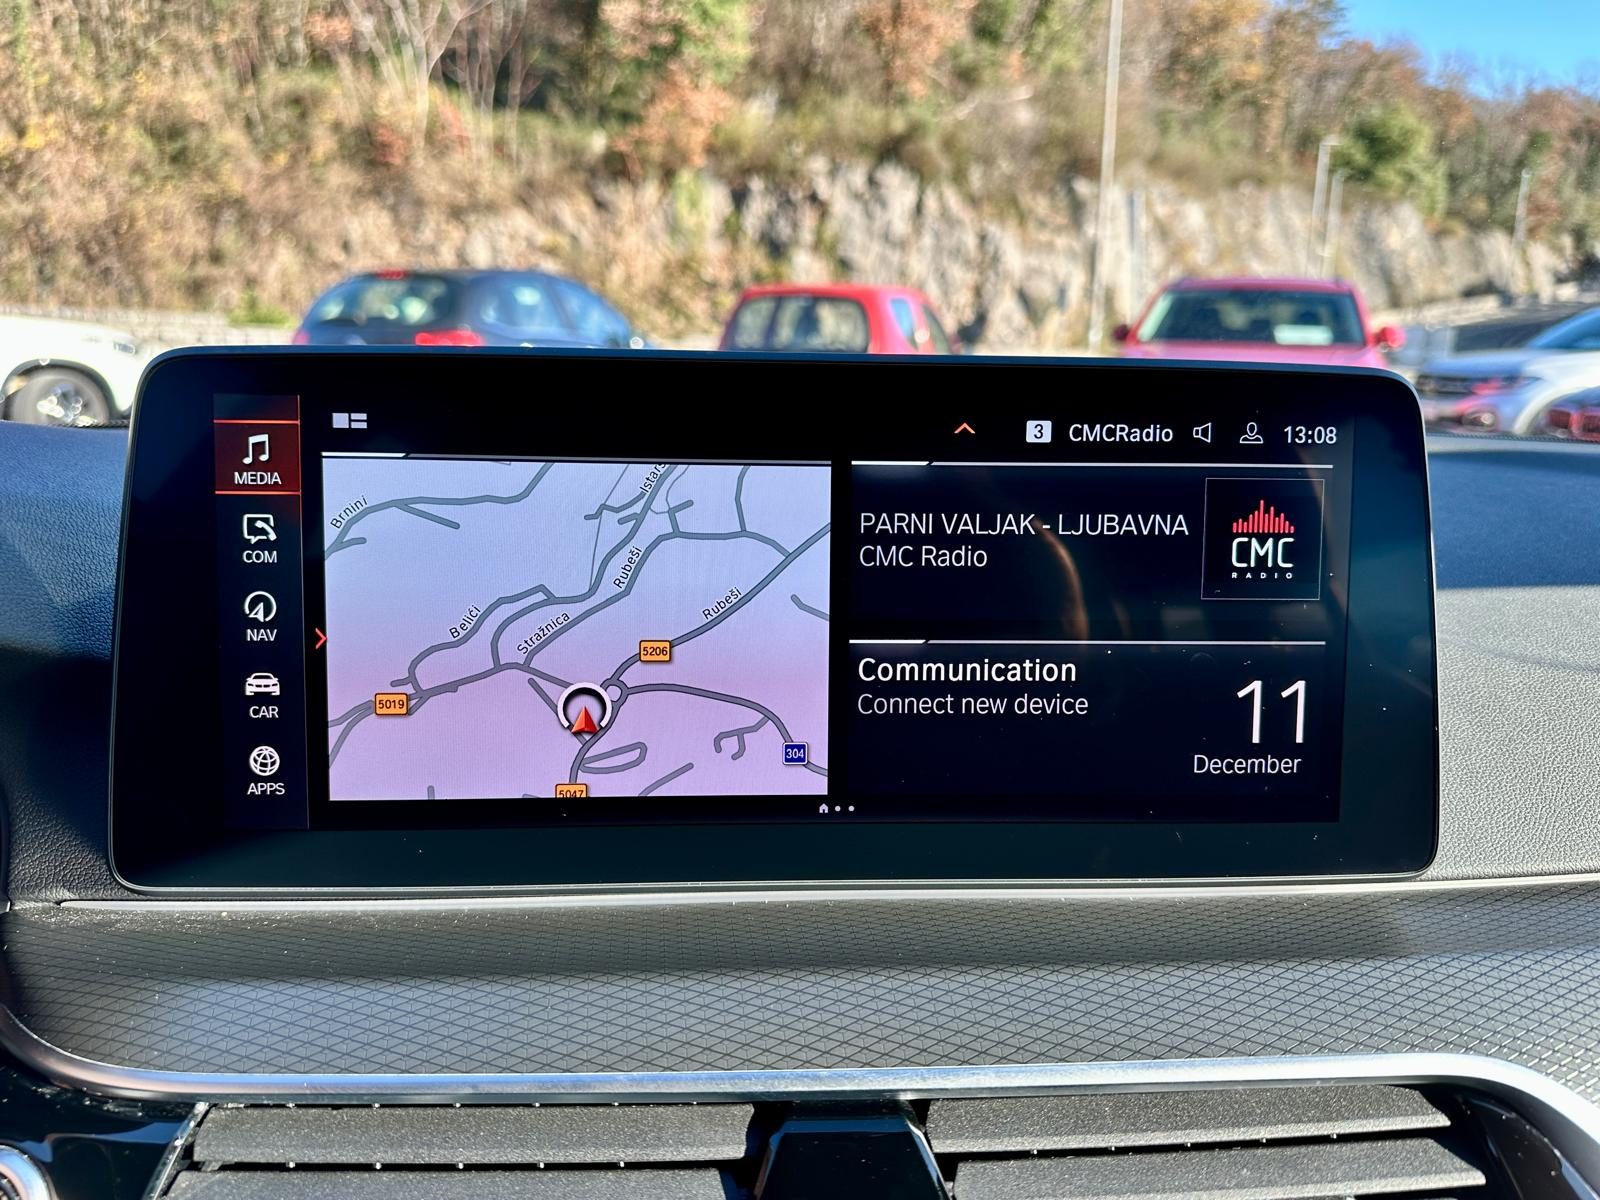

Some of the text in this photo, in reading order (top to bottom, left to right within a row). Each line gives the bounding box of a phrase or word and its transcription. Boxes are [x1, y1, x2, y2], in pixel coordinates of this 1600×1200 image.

[1033, 423, 1044, 440] 3
[1068, 424, 1174, 443] CMCRadio
[1283, 426, 1337, 444] 13:08
[234, 471, 282, 485] MEDIA
[330, 495, 368, 529] Brnini
[859, 513, 934, 535] PARNI
[941, 513, 1036, 536] VALJAK
[1058, 514, 1189, 536] LJUBAVNA
[242, 551, 278, 564] COM
[859, 546, 988, 568] CMC Radio
[1231, 537, 1295, 568] CMC
[613, 545, 643, 589] Rubeši
[702, 587, 742, 620] Rubeši
[449, 605, 481, 640] Belići
[246, 629, 277, 641] NAV
[516, 611, 571, 655] Stražnica
[642, 643, 668, 657] 5206
[858, 658, 1077, 683] Communication
[249, 706, 279, 718] CAR
[378, 698, 405, 711] 5019
[857, 694, 1088, 715] Connect new device
[1236, 680, 1306, 744] 11
[786, 749, 804, 759] 304
[1193, 754, 1302, 774] December
[247, 783, 285, 795] APPS
